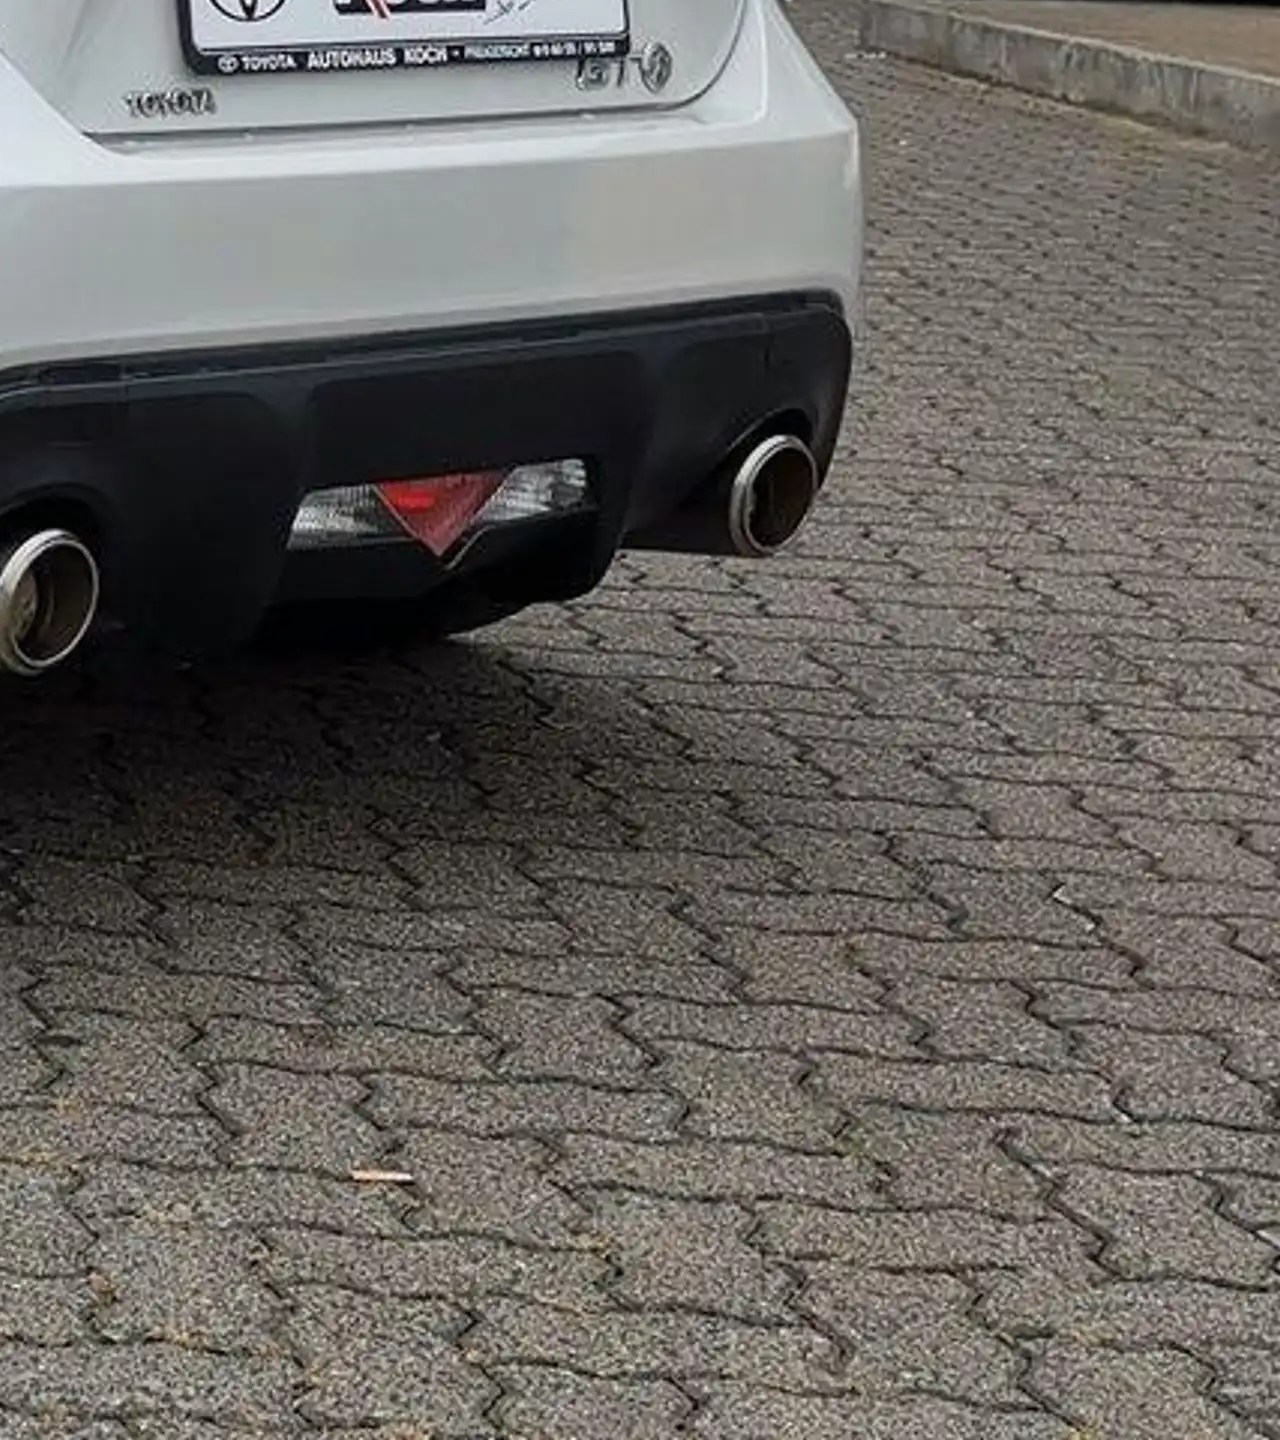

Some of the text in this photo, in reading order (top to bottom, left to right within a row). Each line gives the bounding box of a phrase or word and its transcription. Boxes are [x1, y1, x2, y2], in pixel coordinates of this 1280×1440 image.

[242, 55, 298, 71] TOYOTA
[307, 47, 396, 69] AUTOHAUS
[403, 44, 448, 65] KOCH
[121, 88, 218, 119] TOYOTA
